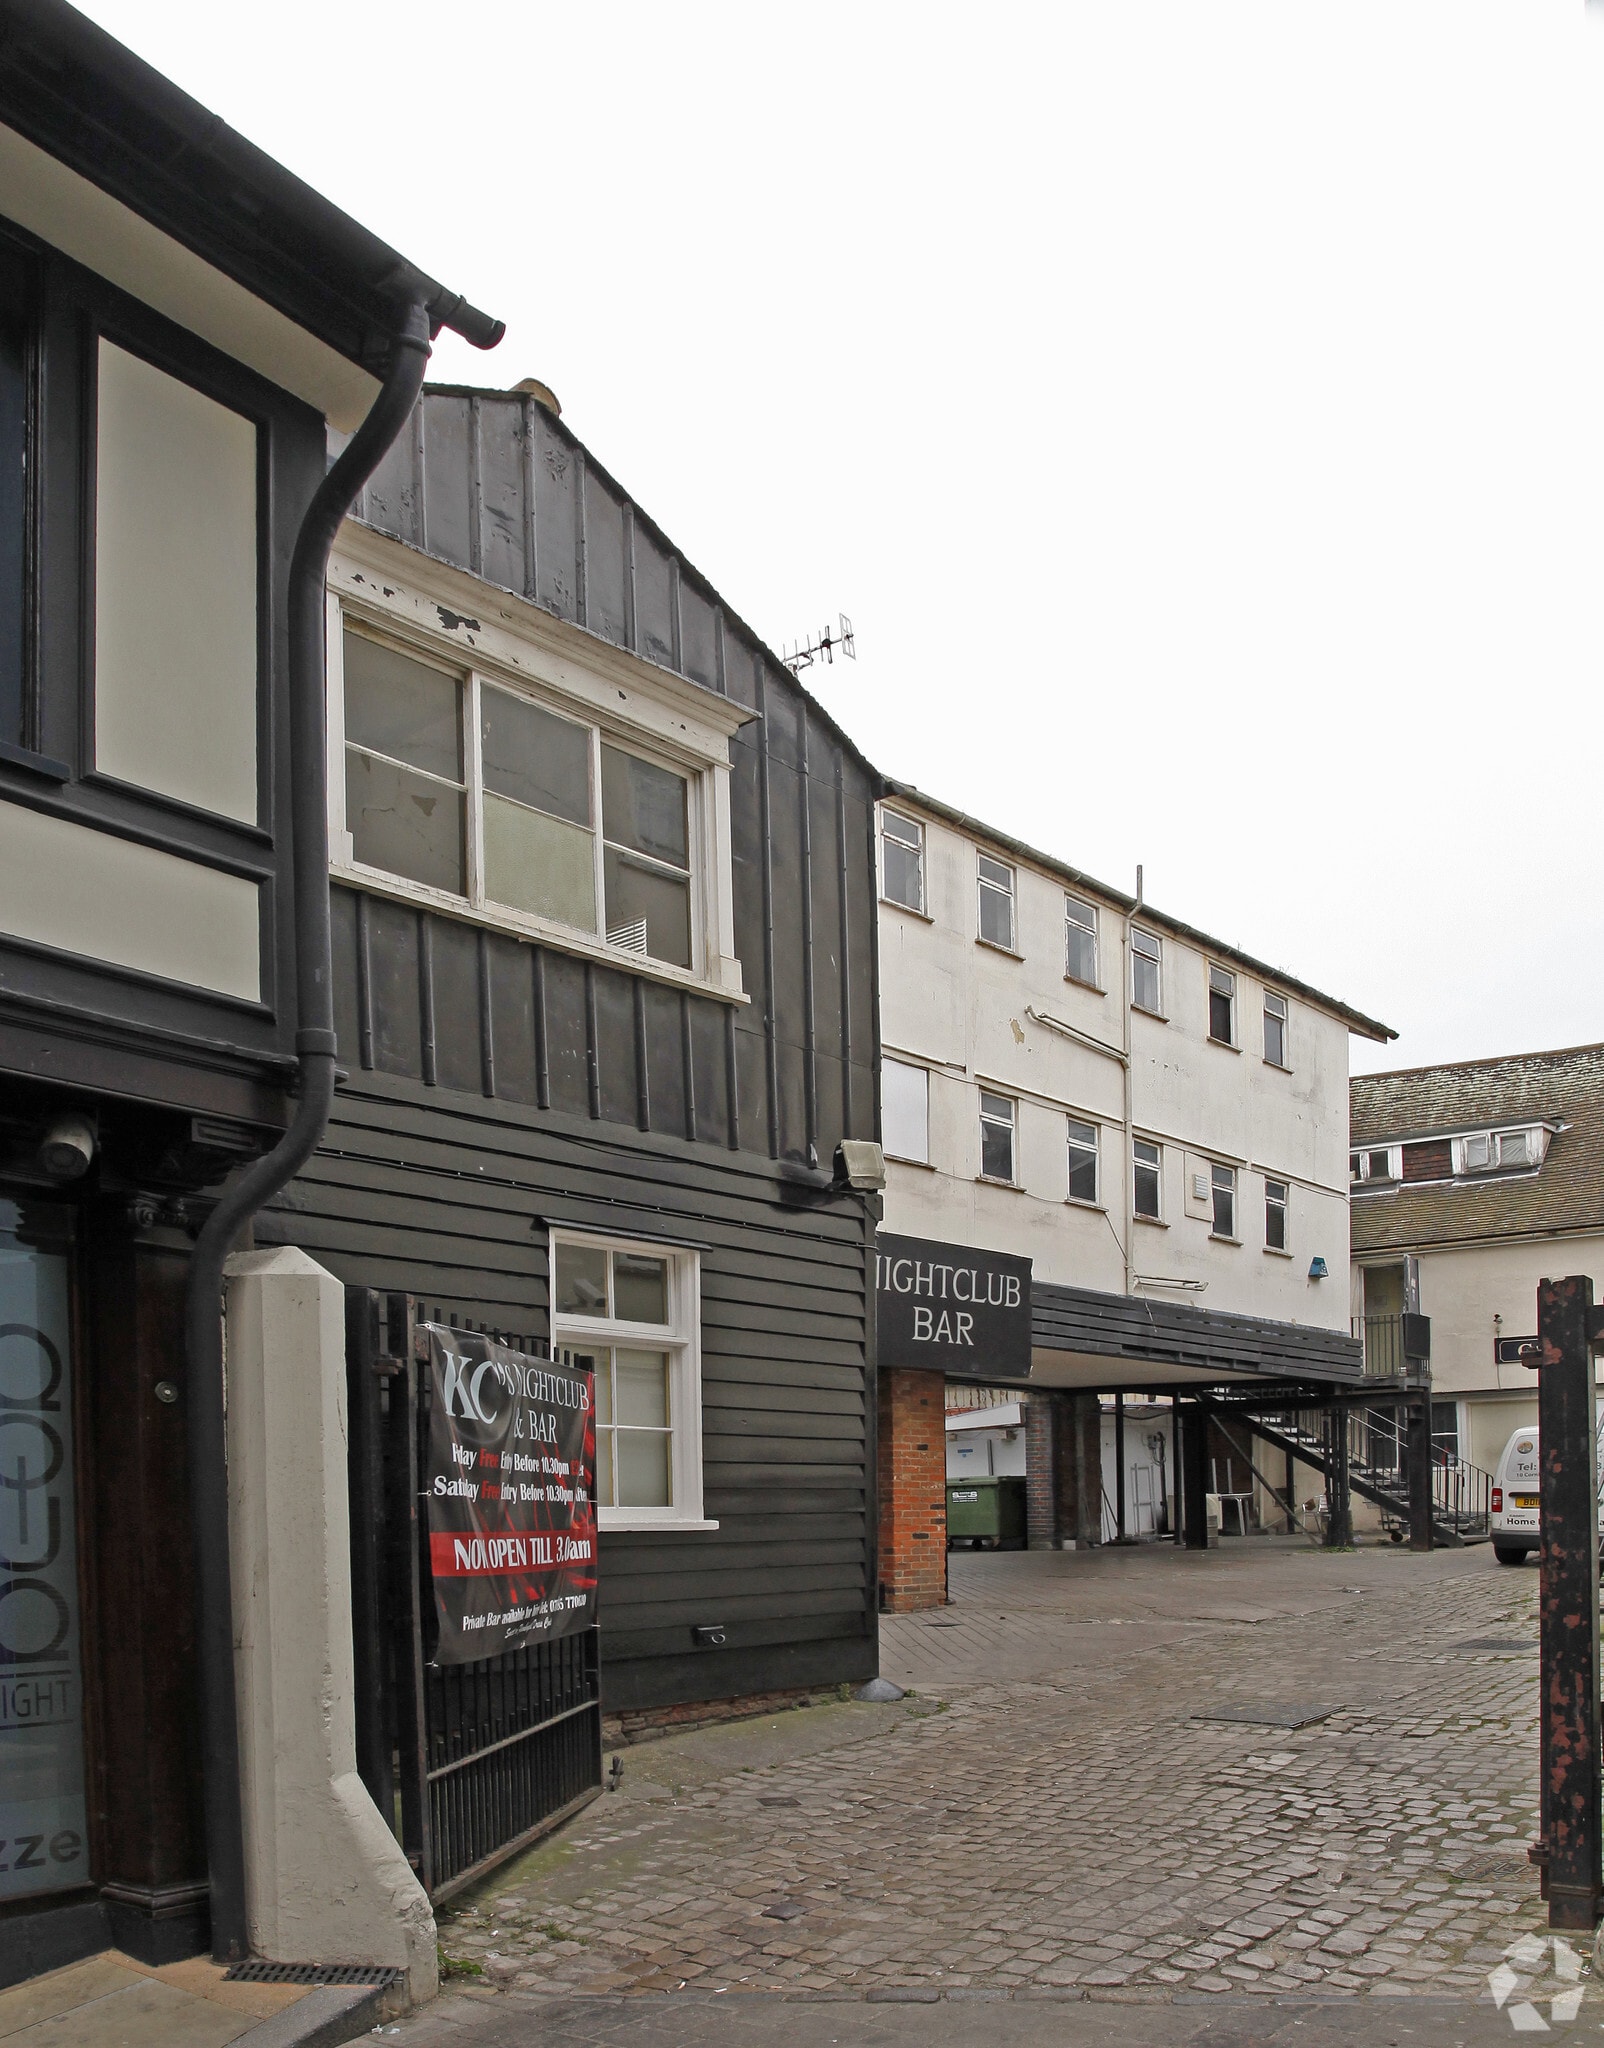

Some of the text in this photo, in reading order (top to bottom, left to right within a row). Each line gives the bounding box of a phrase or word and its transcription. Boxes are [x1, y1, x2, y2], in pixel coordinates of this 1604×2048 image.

[912, 1306, 974, 1346] BAR
[512, 1363, 590, 1411] NIGHTCLUB
[513, 1407, 558, 1444] & BAR
[514, 1453, 540, 1473] Before
[541, 1456, 570, 1478] 10.30pm
[1517, 1462, 1537, 1471] Tel:
[519, 1482, 545, 1501] Before
[1506, 1518, 1536, 1526] Home
[488, 1537, 527, 1569] OPEN
[529, 1536, 554, 1565] TILL
[486, 1611, 501, 1627] Bar
